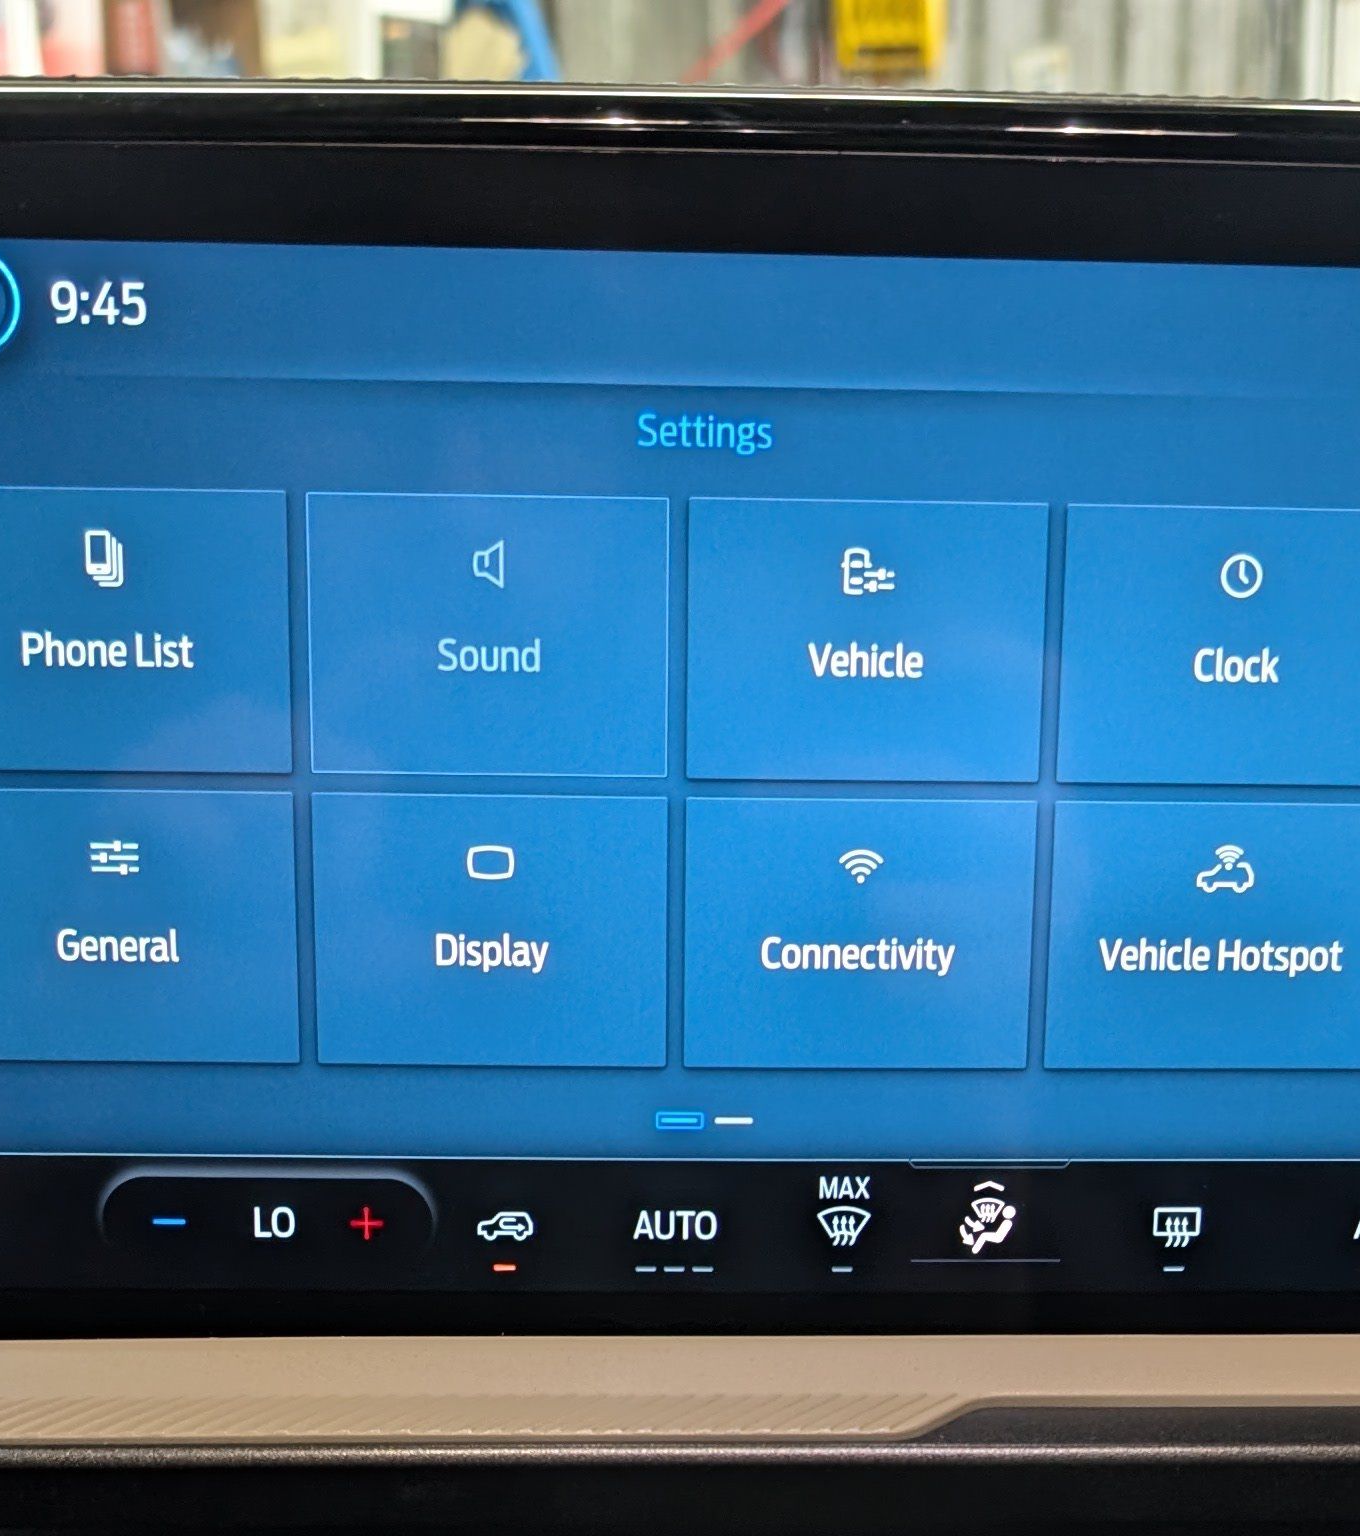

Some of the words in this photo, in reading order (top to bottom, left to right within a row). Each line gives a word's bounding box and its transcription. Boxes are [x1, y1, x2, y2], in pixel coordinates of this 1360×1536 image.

[49, 280, 148, 327] 9:45
[636, 412, 774, 456] Settings
[20, 631, 129, 670] Phone
[134, 632, 195, 670] List
[436, 637, 542, 674] Sound
[807, 641, 926, 681] Vehicle
[1192, 646, 1281, 684] Clock
[55, 928, 181, 965] General
[434, 932, 551, 975] Display
[759, 935, 957, 978] Connectivity
[1098, 937, 1211, 974] Vehicle
[1216, 937, 1345, 979] Hotspot
[817, 1175, 872, 1202] MAX
[252, 1206, 297, 1239] LO
[631, 1209, 720, 1242] AUTO
